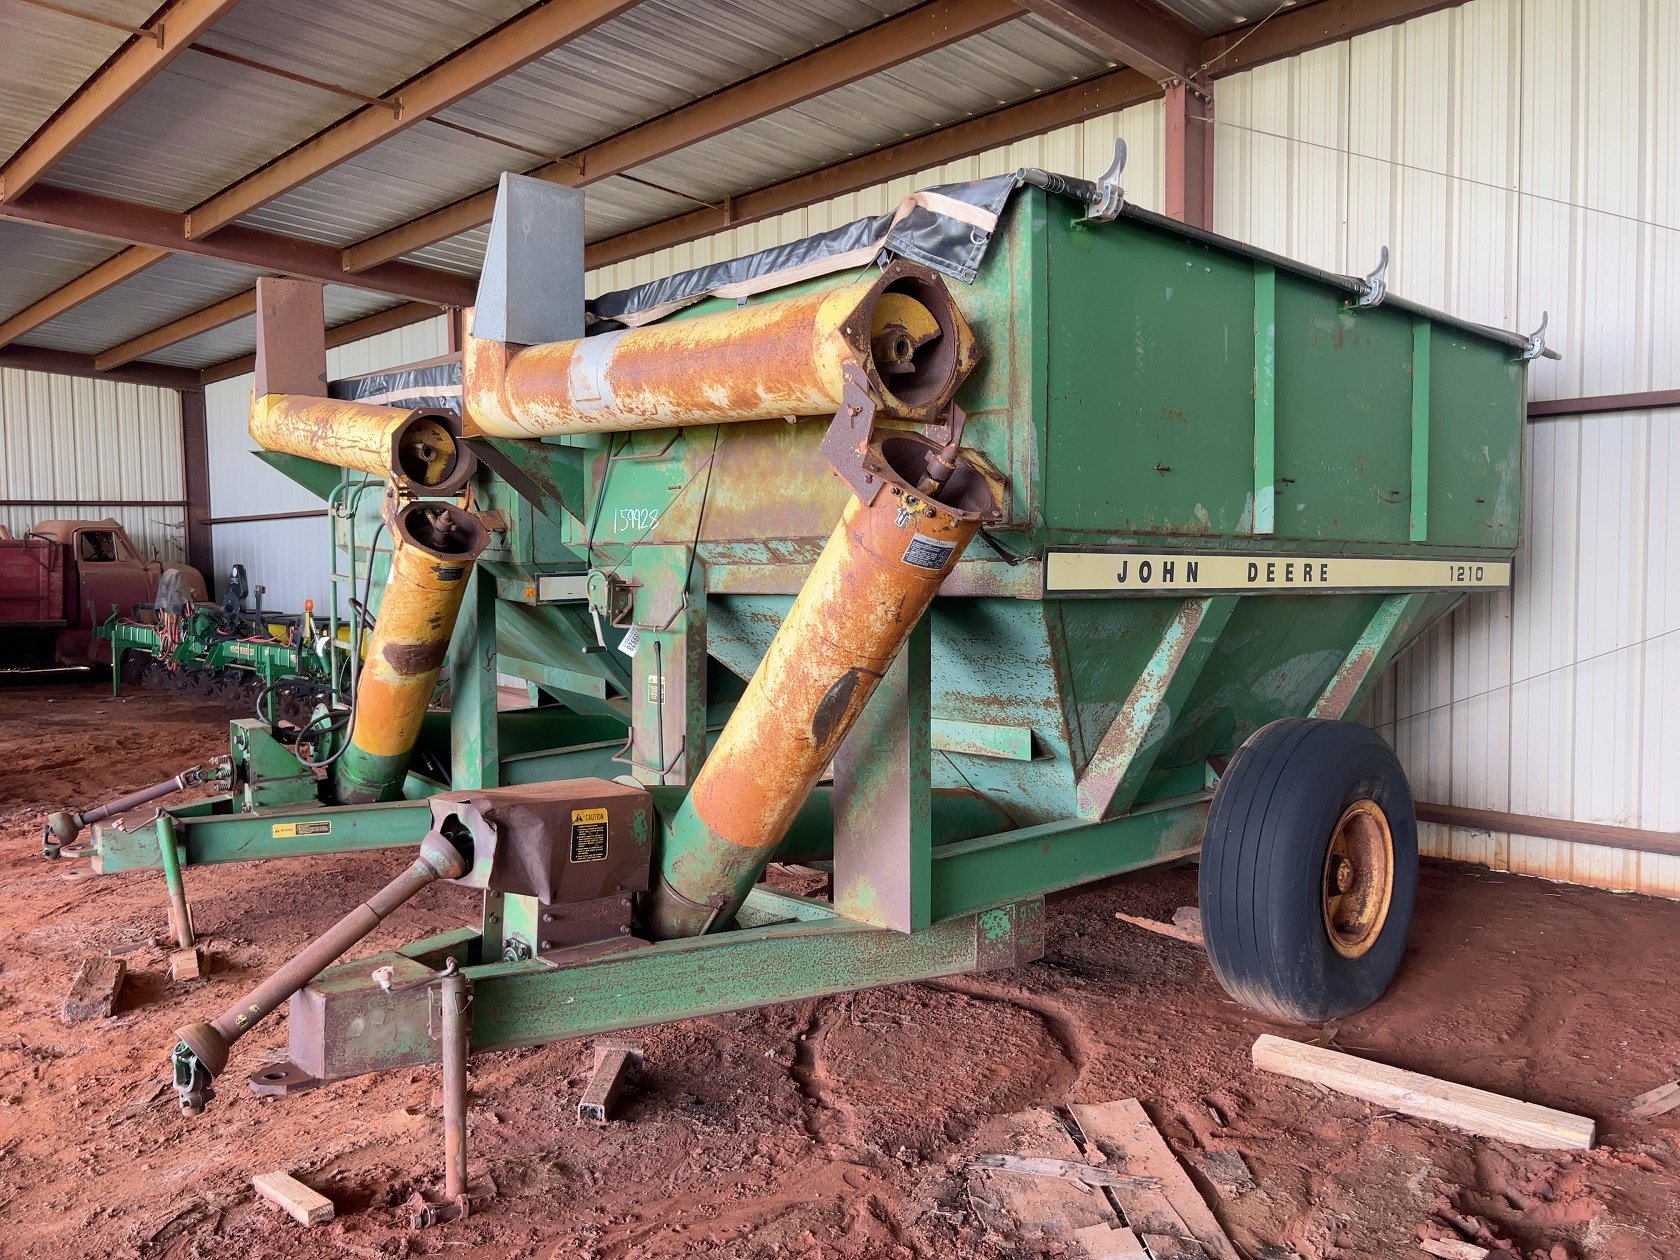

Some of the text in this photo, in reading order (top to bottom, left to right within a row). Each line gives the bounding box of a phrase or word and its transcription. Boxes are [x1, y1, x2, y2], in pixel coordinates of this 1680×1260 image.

[613, 508, 659, 534] 159928
[1117, 560, 1484, 583] JOHN DEERE 1210
